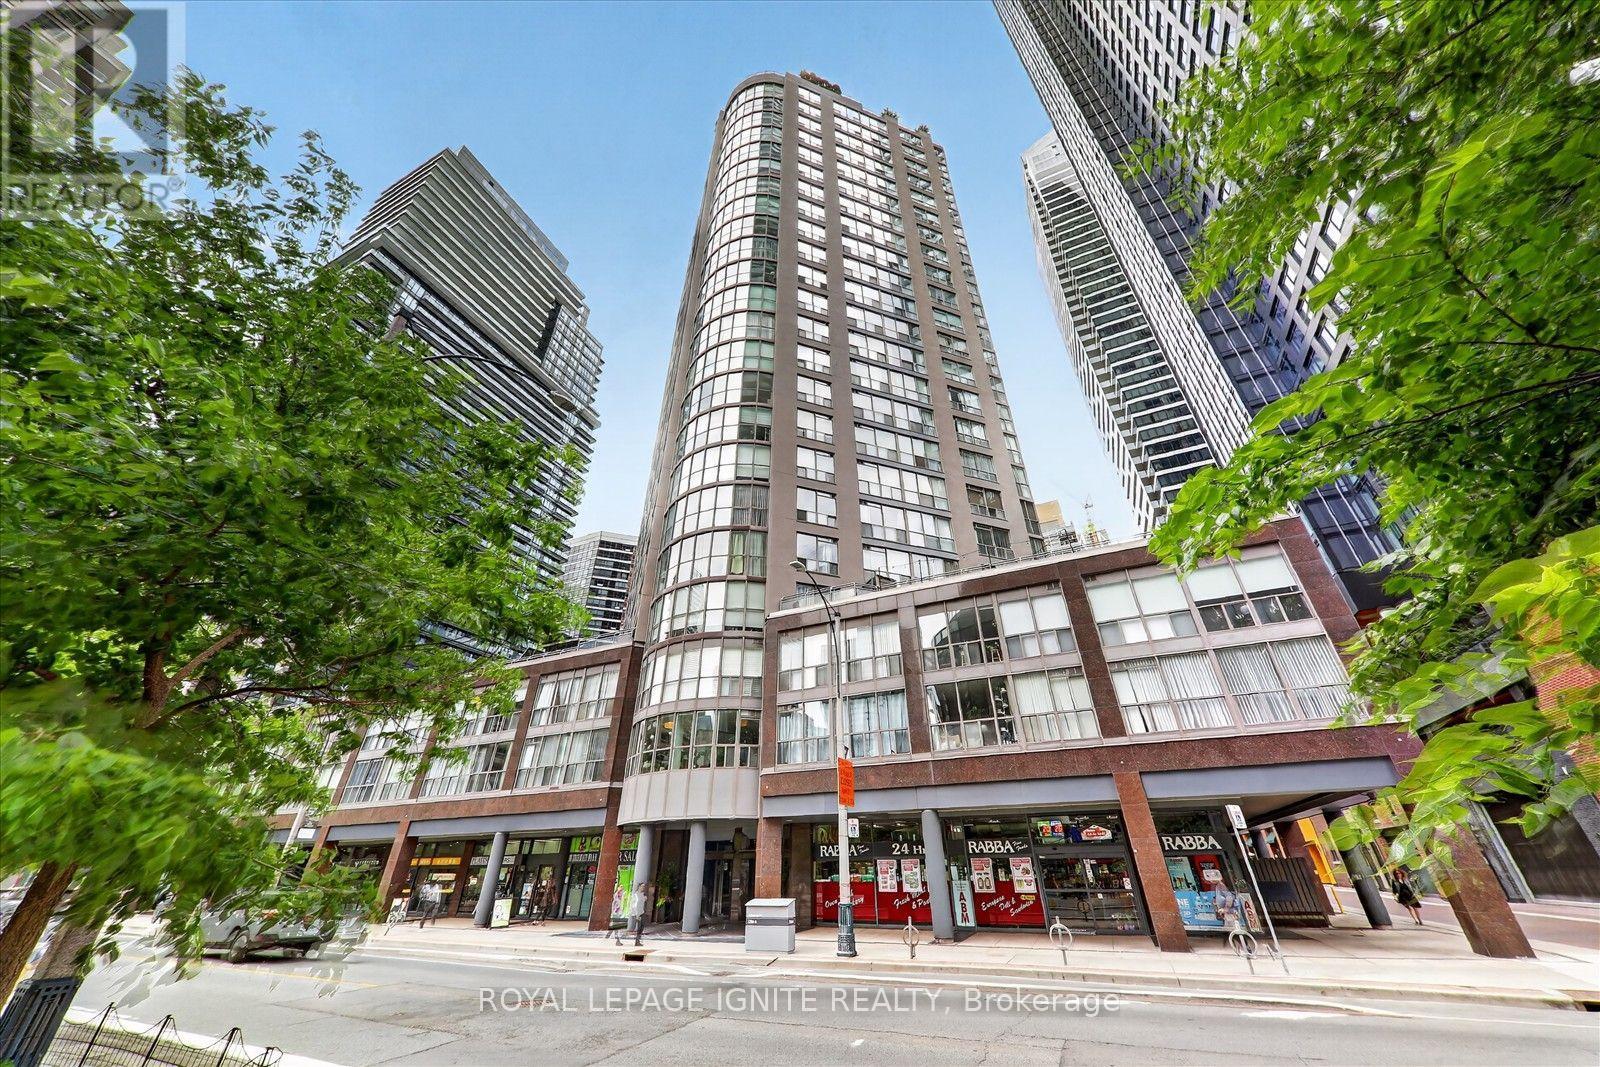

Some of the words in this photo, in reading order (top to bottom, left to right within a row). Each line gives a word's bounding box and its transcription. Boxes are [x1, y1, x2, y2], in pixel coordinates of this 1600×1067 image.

[820, 844, 858, 857] RABA
[892, 843, 910, 855] 24
[968, 840, 1015, 854] RABBA
[1161, 836, 1222, 851] RABBA
[959, 891, 971, 924] ABM
